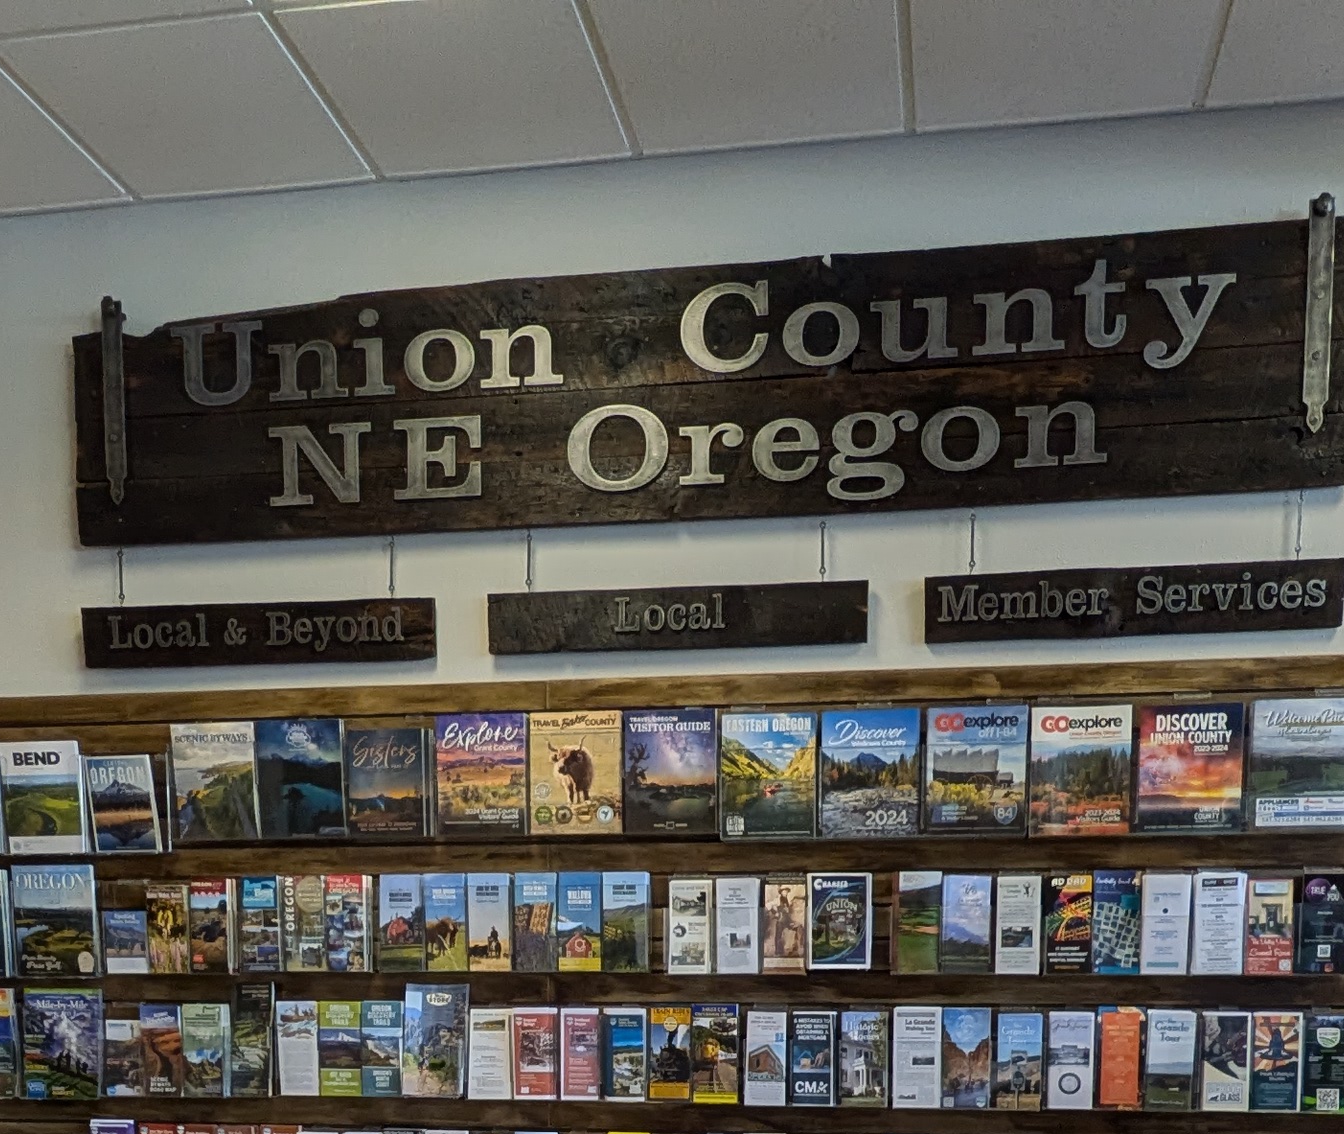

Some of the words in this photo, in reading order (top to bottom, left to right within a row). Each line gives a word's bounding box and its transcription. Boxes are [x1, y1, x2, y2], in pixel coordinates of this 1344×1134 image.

[170, 308, 563, 406] Union
[680, 259, 1236, 373] County
[269, 415, 484, 507] NE
[568, 400, 1108, 501] Oregon
[936, 582, 1109, 624] Member
[1137, 573, 1326, 616] Services
[614, 594, 726, 634] Local
[108, 613, 211, 649] Local
[224, 614, 248, 645] &
[267, 604, 405, 651] Beyond
[533, 719, 561, 727] TRAVEL
[585, 718, 616, 726] COUNTY
[630, 722, 674, 732] VISITOR
[675, 721, 711, 731] GUIDE
[727, 718, 769, 733] EASTERN
[772, 717, 811, 732] OREGON
[1155, 712, 1228, 731] DISCOVER
[1263, 710, 1321, 727] Welcome
[175, 733, 209, 744] SCENIC
[210, 732, 248, 744] BYWAYS
[442, 721, 518, 752] Explore
[828, 719, 906, 745] Discover
[1150, 731, 1185, 745] UNION
[1188, 730, 1232, 744] COUNTY
[353, 735, 418, 768] Sisters
[493, 744, 519, 752] County
[12, 751, 60, 766] BEND
[90, 765, 145, 785] OREGON
[865, 809, 908, 826] 2024
[997, 807, 1014, 819] 84
[1194, 812, 1220, 820] COUNTY
[16, 873, 86, 890] OREGON
[285, 877, 295, 931] OREGON
[826, 901, 858, 911] UNION
[1155, 1022, 1190, 1032] Grande
[1160, 1032, 1180, 1042] Tour
[1220, 1093, 1240, 1102] GLASS
